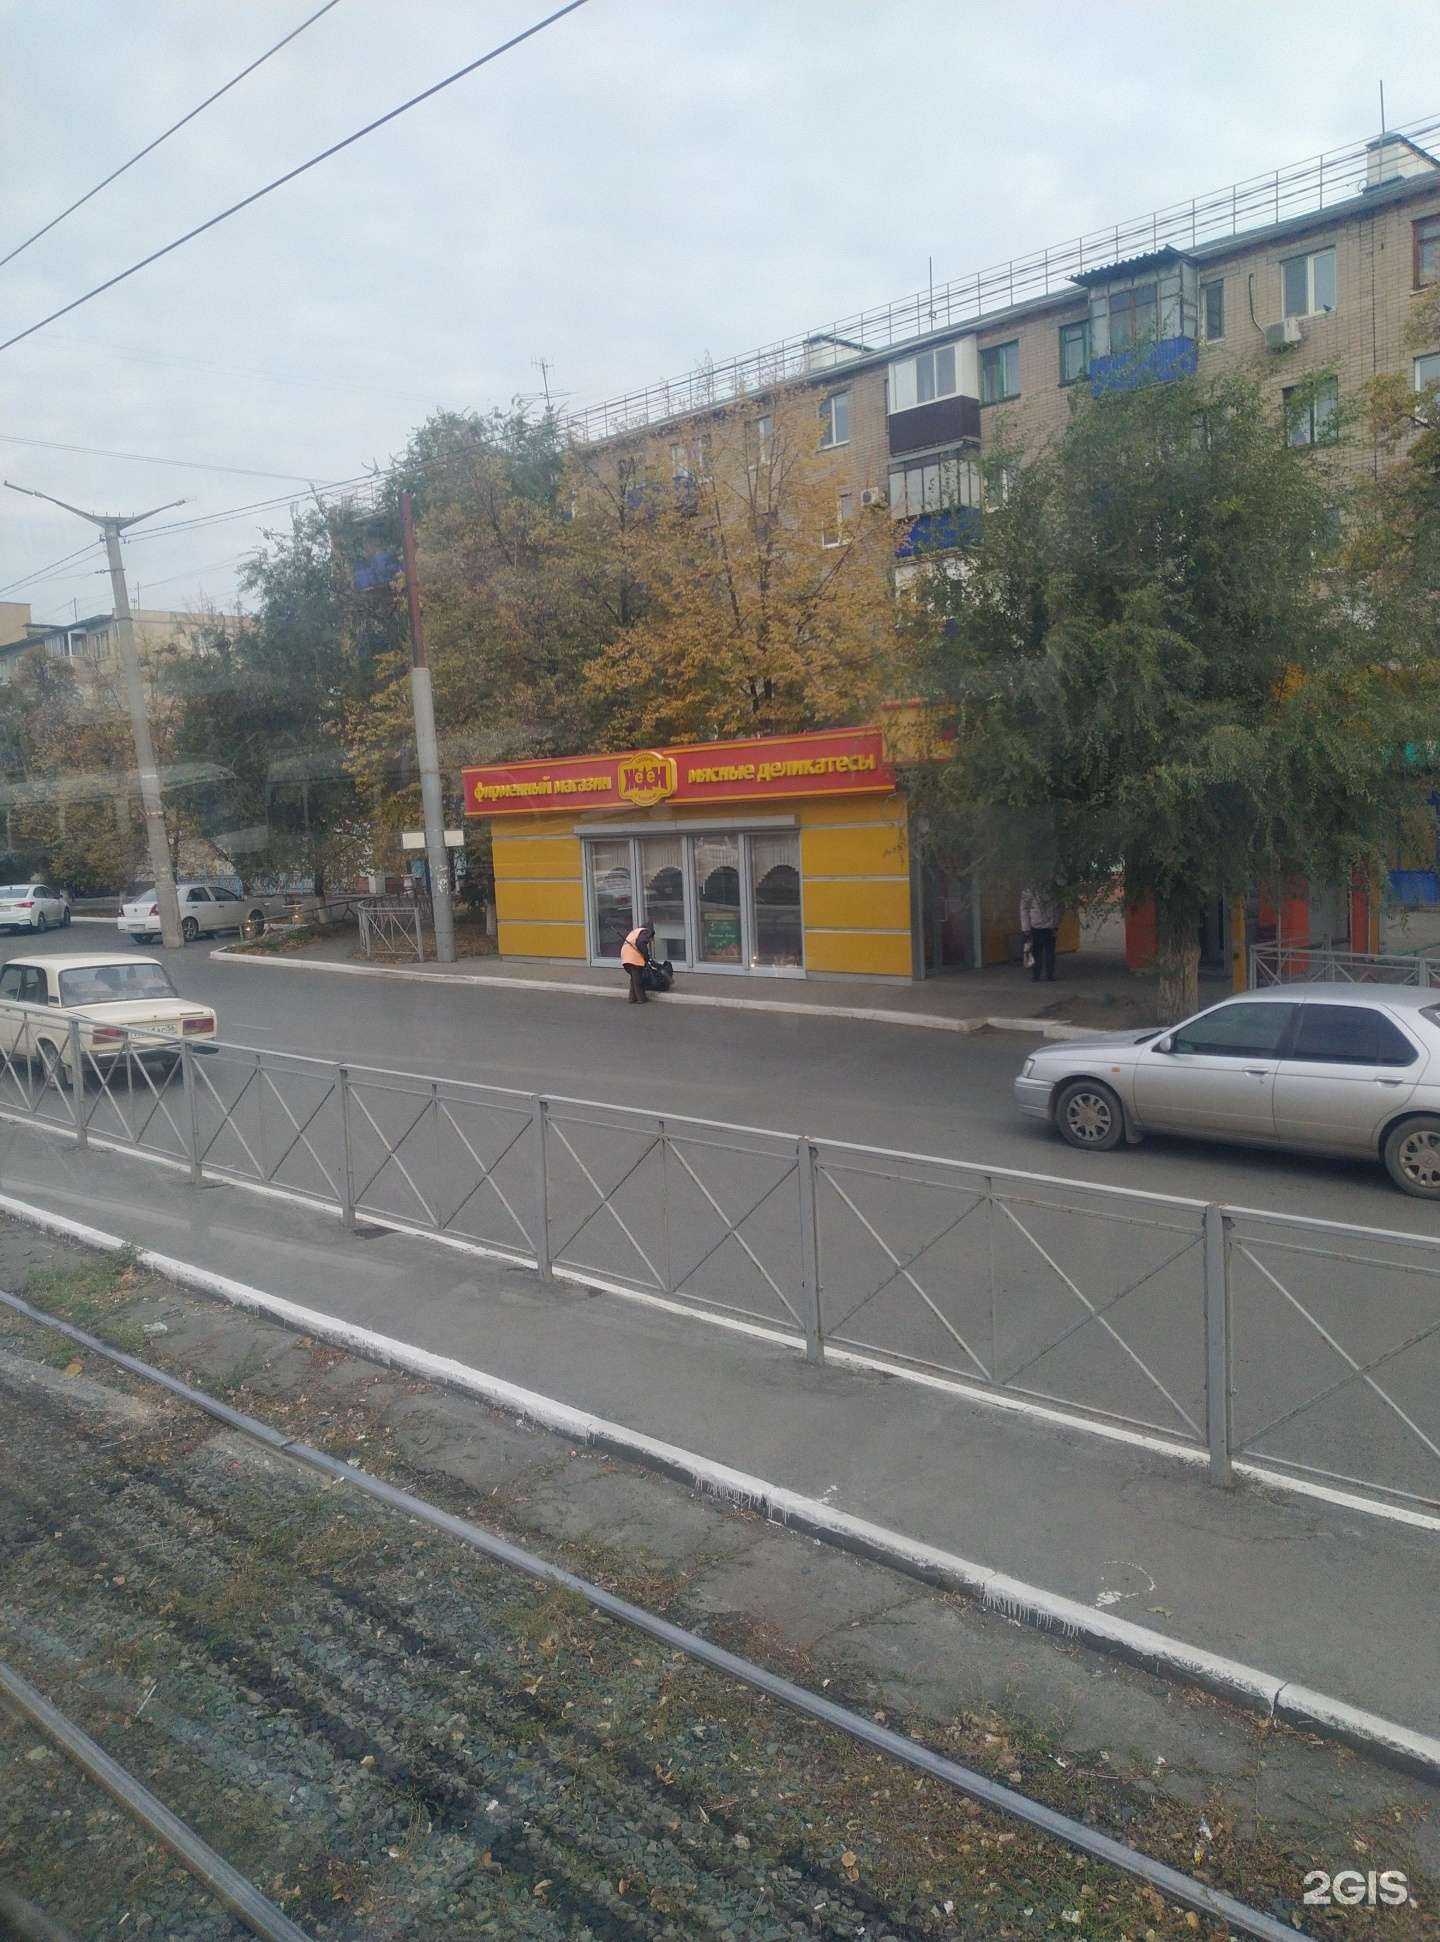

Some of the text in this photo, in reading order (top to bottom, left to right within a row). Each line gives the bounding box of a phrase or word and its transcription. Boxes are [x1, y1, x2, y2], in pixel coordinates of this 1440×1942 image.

[687, 753, 877, 784] мясные деликатесы
[474, 776, 612, 802] фирменный магазин
